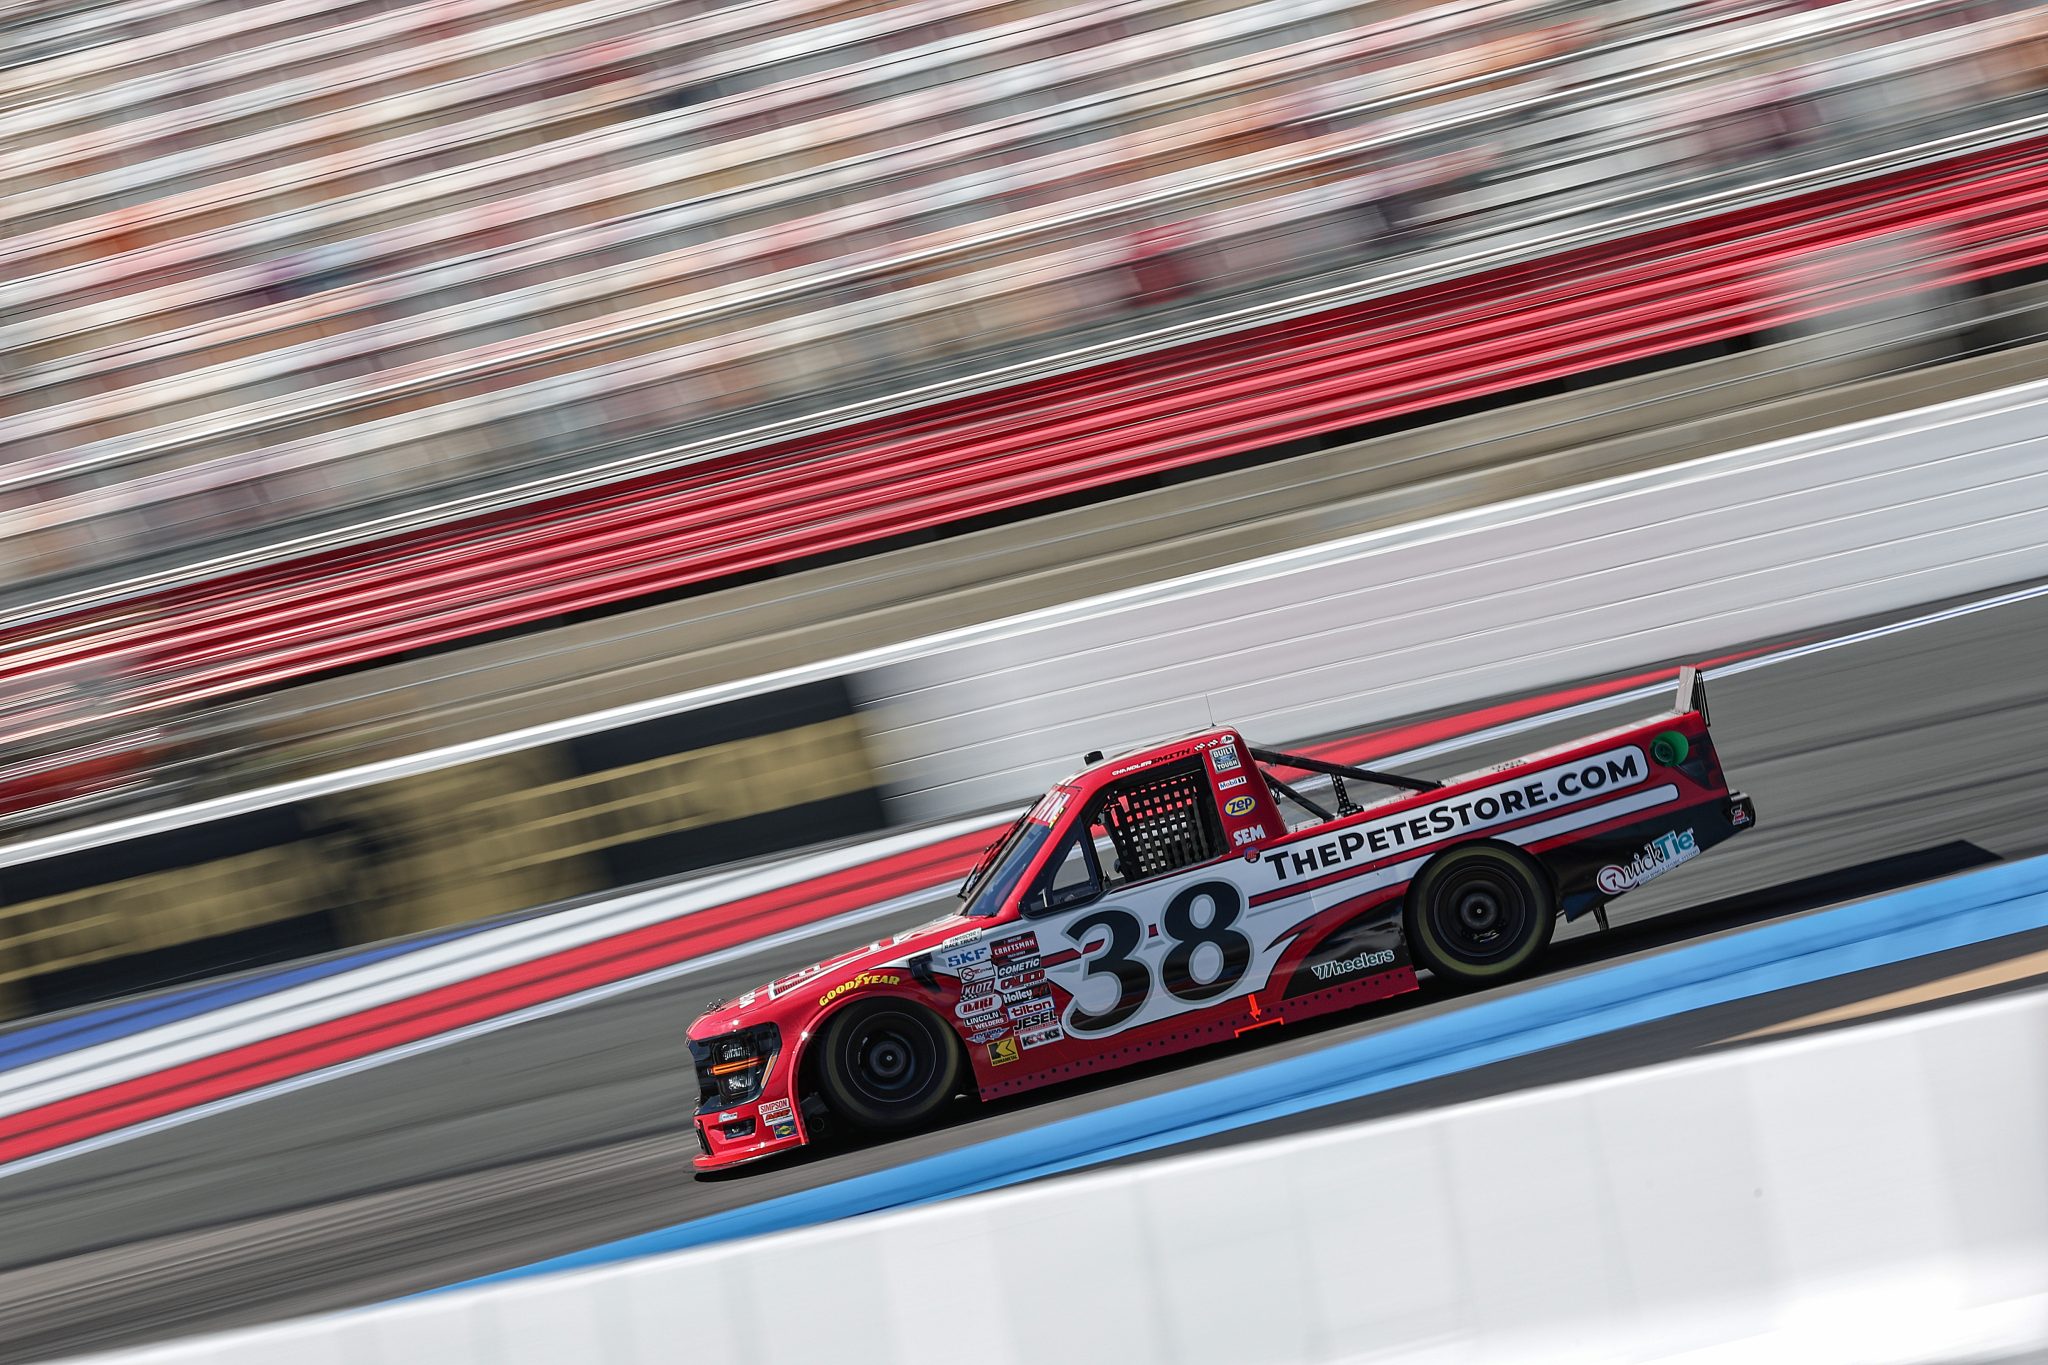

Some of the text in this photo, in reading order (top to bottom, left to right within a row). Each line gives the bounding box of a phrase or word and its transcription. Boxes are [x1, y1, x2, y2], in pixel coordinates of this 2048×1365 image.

[1213, 747, 1234, 758] BUILT
[1112, 748, 1191, 776] CHANDLER SMITH
[1217, 760, 1238, 770] TOUGH
[1220, 779, 1238, 789] Mobil
[1233, 824, 1266, 846] SEM
[994, 939, 1035, 956] CRAFTSMAN
[948, 947, 987, 967] SKF
[1061, 877, 1254, 1038] 38
[1311, 950, 1395, 980] Wheelers
[999, 958, 1040, 976] COMETIC
[819, 972, 900, 1006] GOODYEAR
[965, 980, 993, 996] KLOTZ
[1002, 989, 1033, 1004] Holley
[1011, 1001, 1052, 1017] tilton
[966, 1012, 999, 1026] LINCOLN
[974, 1018, 1005, 1030] WELDERS
[1013, 1010, 1057, 1031] JESEL
[1021, 1028, 1060, 1048] KOOKS
[760, 1099, 788, 1113] SIMPSON
